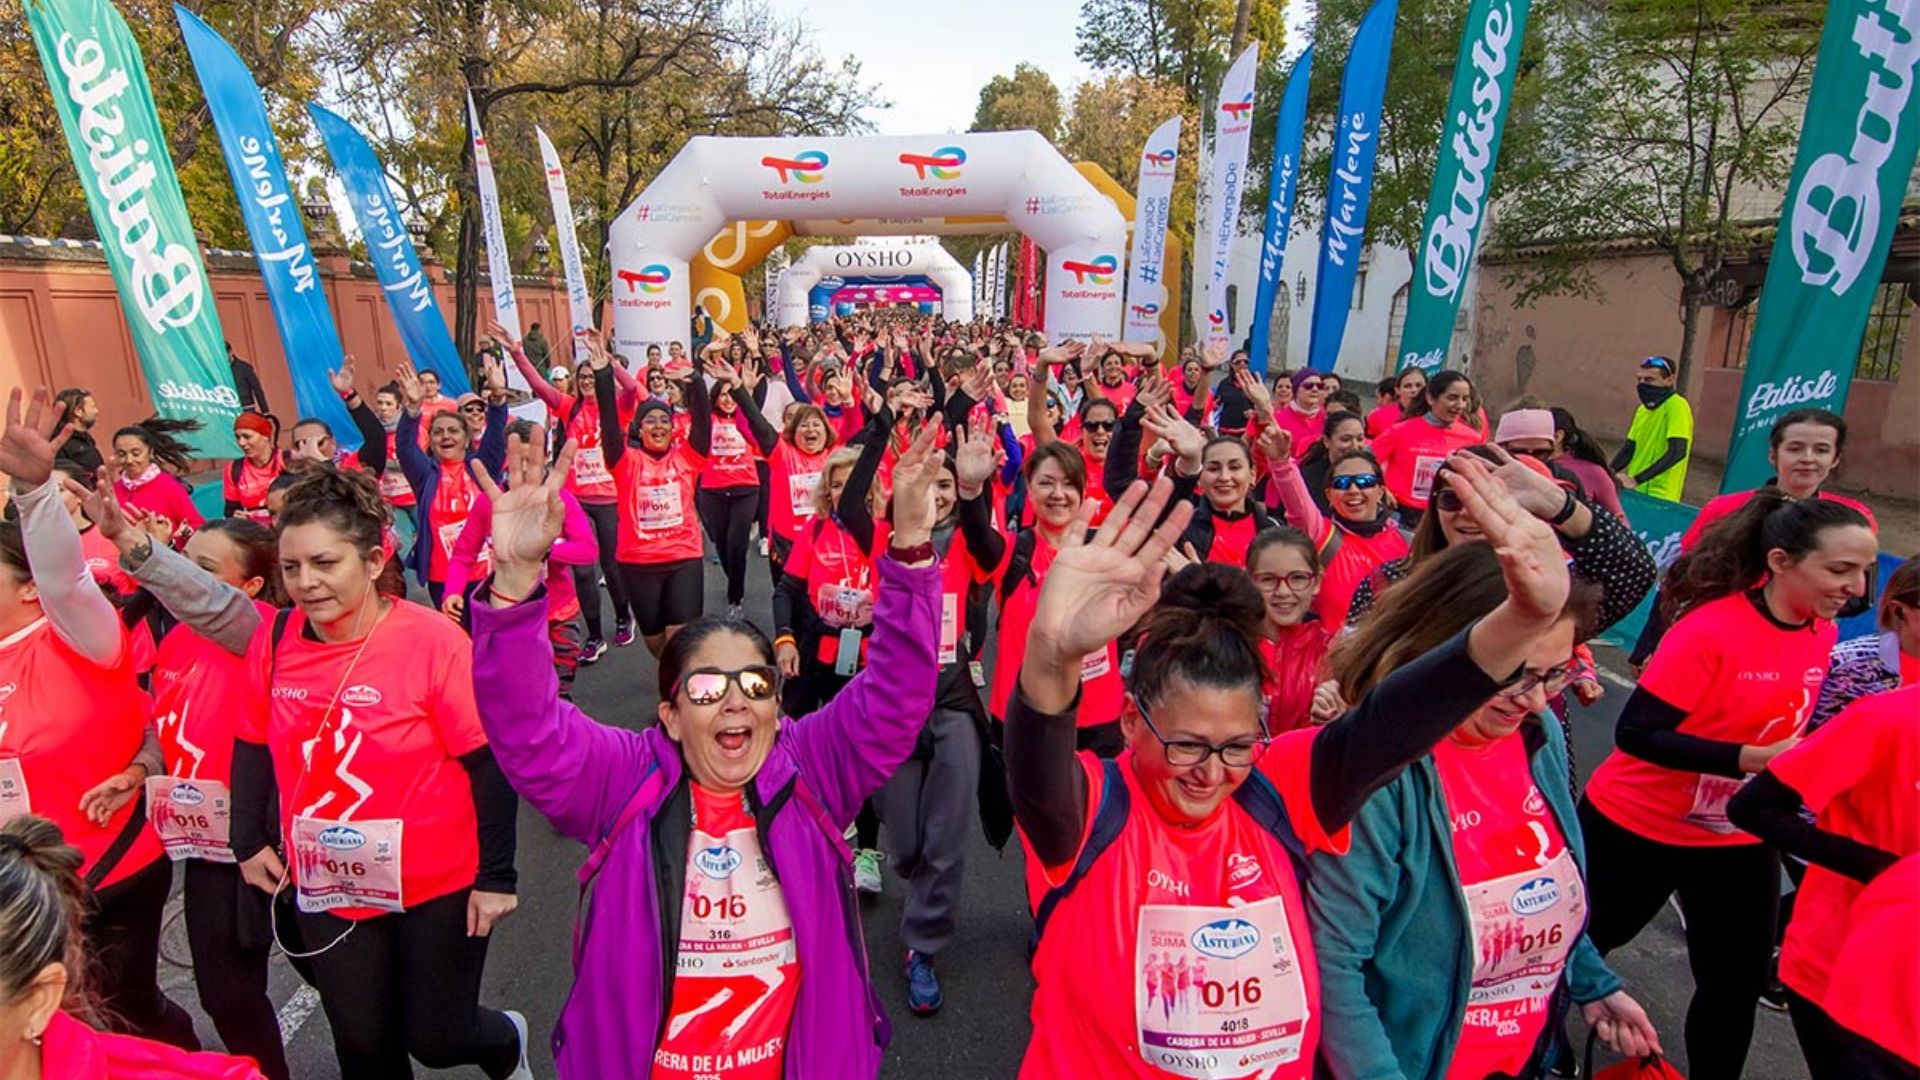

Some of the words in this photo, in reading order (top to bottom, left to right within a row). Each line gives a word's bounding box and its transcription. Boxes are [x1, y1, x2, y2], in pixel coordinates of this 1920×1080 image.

[1425, 2, 1513, 303] Batiste
[762, 190, 831, 201] TotalEnergies
[899, 187, 967, 197] TotalEnergies
[1328, 112, 1370, 266] Marlene
[1263, 153, 1292, 282] Marlene
[835, 249, 913, 269] OYSHO
[175, 814, 209, 829] 016
[325, 859, 366, 876] 016
[693, 894, 746, 919] 016
[709, 929, 731, 940] 316
[1519, 923, 1562, 954] 016
[1202, 976, 1262, 1008] 016
[1220, 1018, 1249, 1032] 4018
[1166, 1034, 1205, 1047] CARRERA
[1208, 1035, 1219, 1046] DE
[1220, 1034, 1231, 1046] LA
[692, 1056, 713, 1072] DE
[716, 1055, 734, 1072] LA
[1161, 1052, 1218, 1069] OYSHO
